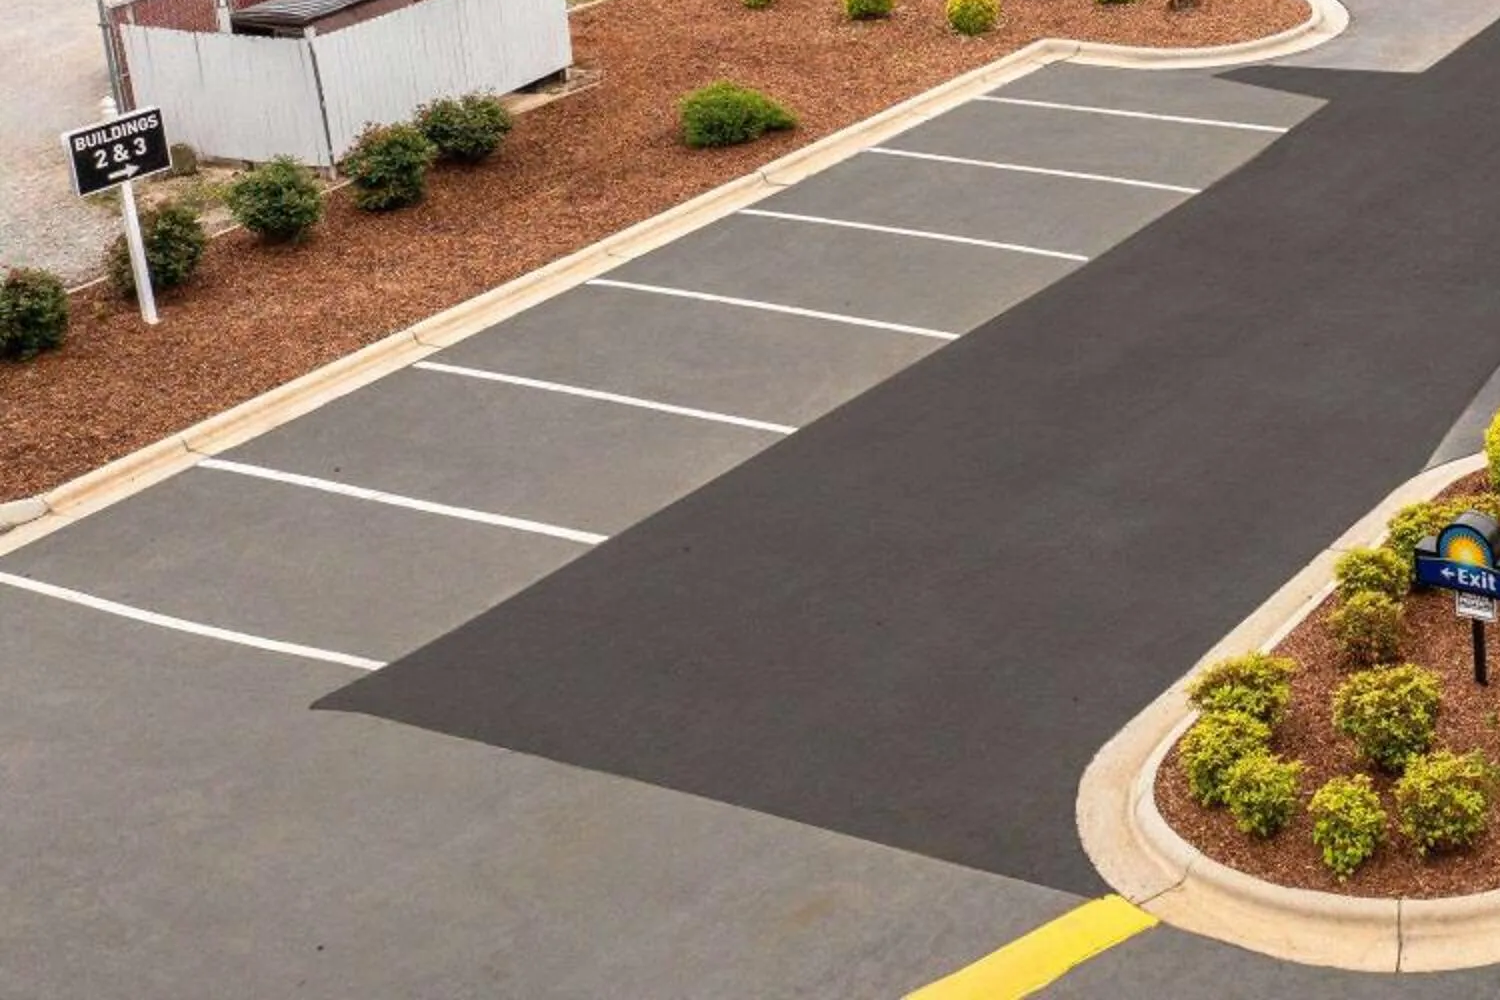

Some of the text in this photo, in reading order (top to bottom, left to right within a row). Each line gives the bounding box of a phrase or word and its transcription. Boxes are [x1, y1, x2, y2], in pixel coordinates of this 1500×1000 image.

[75, 114, 158, 152] BUILDINGS
[95, 136, 147, 169] 2 & 3
[1457, 568, 1497, 591] Exit
